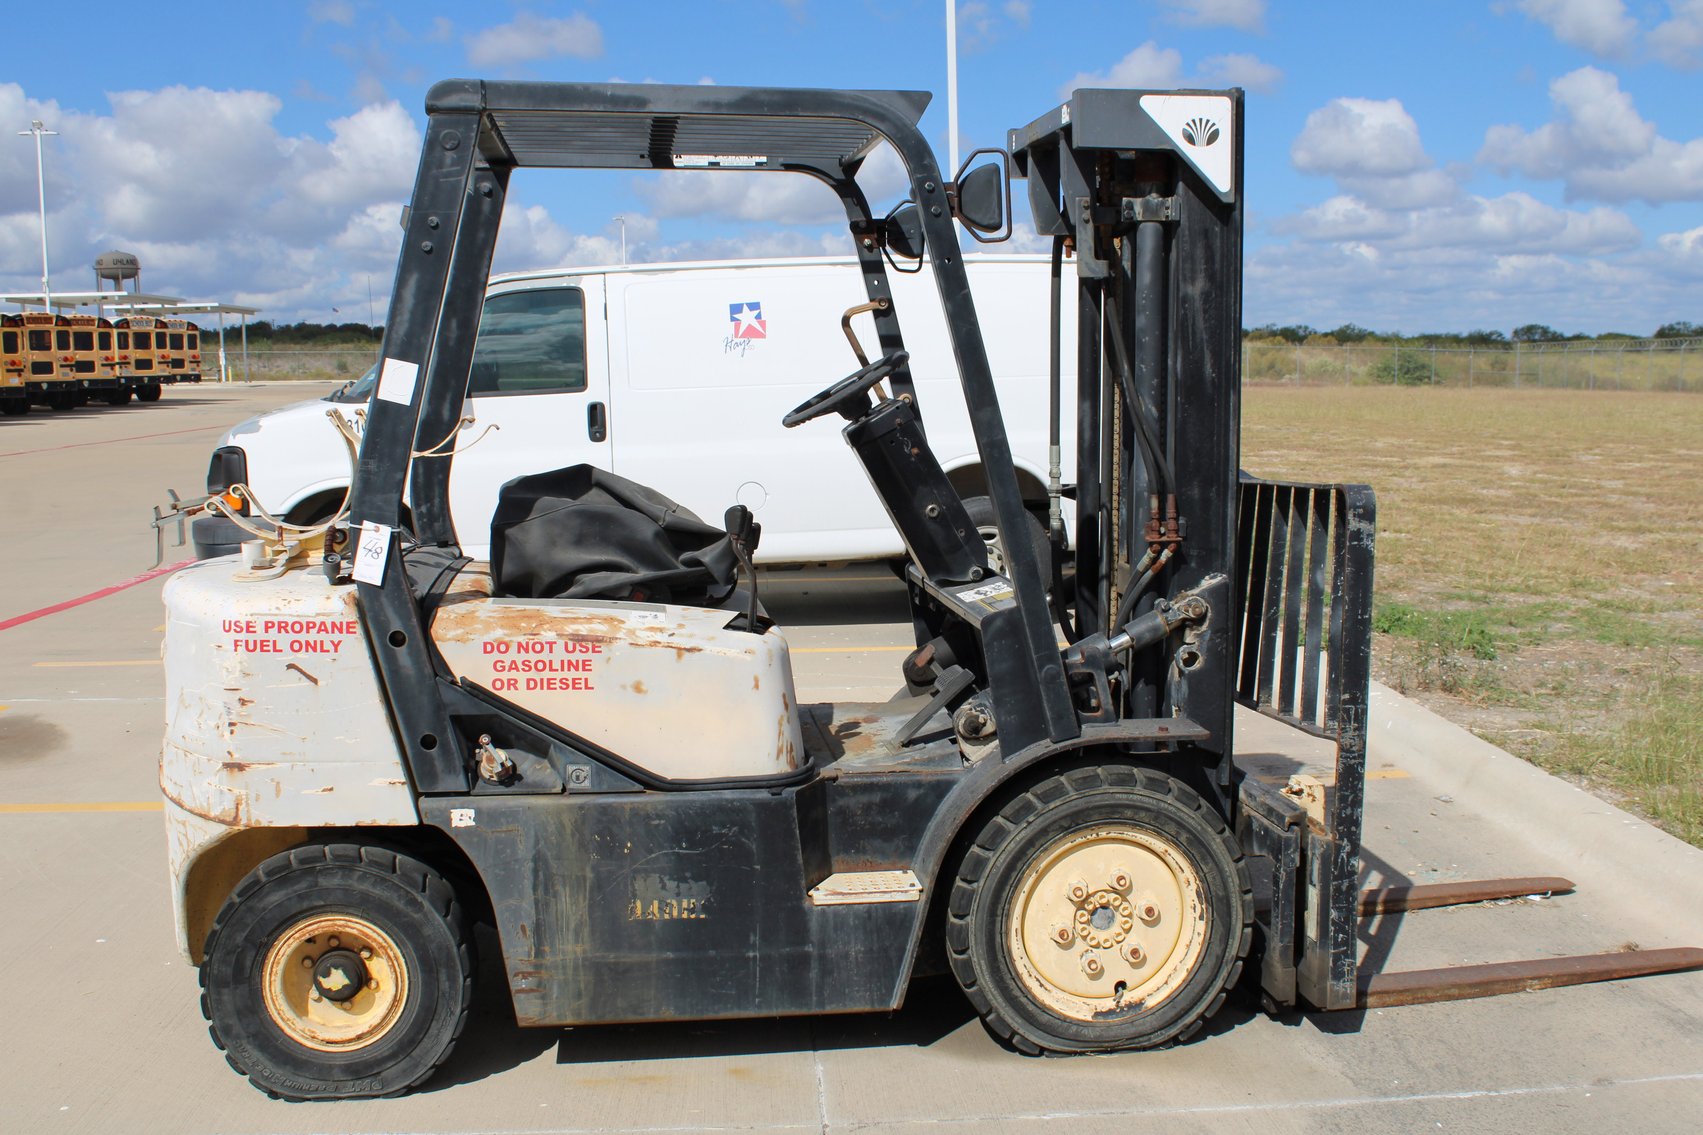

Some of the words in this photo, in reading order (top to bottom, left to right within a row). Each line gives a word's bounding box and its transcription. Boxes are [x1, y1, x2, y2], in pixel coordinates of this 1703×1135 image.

[363, 539, 383, 560] 48
[222, 619, 257, 634] USE
[264, 620, 358, 635] PROPANE
[233, 639, 283, 653] FUEL
[289, 639, 343, 653] ONLY
[482, 641, 510, 654] DO
[516, 641, 557, 654] NOT
[564, 641, 603, 654] USE
[492, 659, 593, 673] GASOLINE
[491, 677, 519, 691] OR
[525, 677, 595, 691] DIESEL
